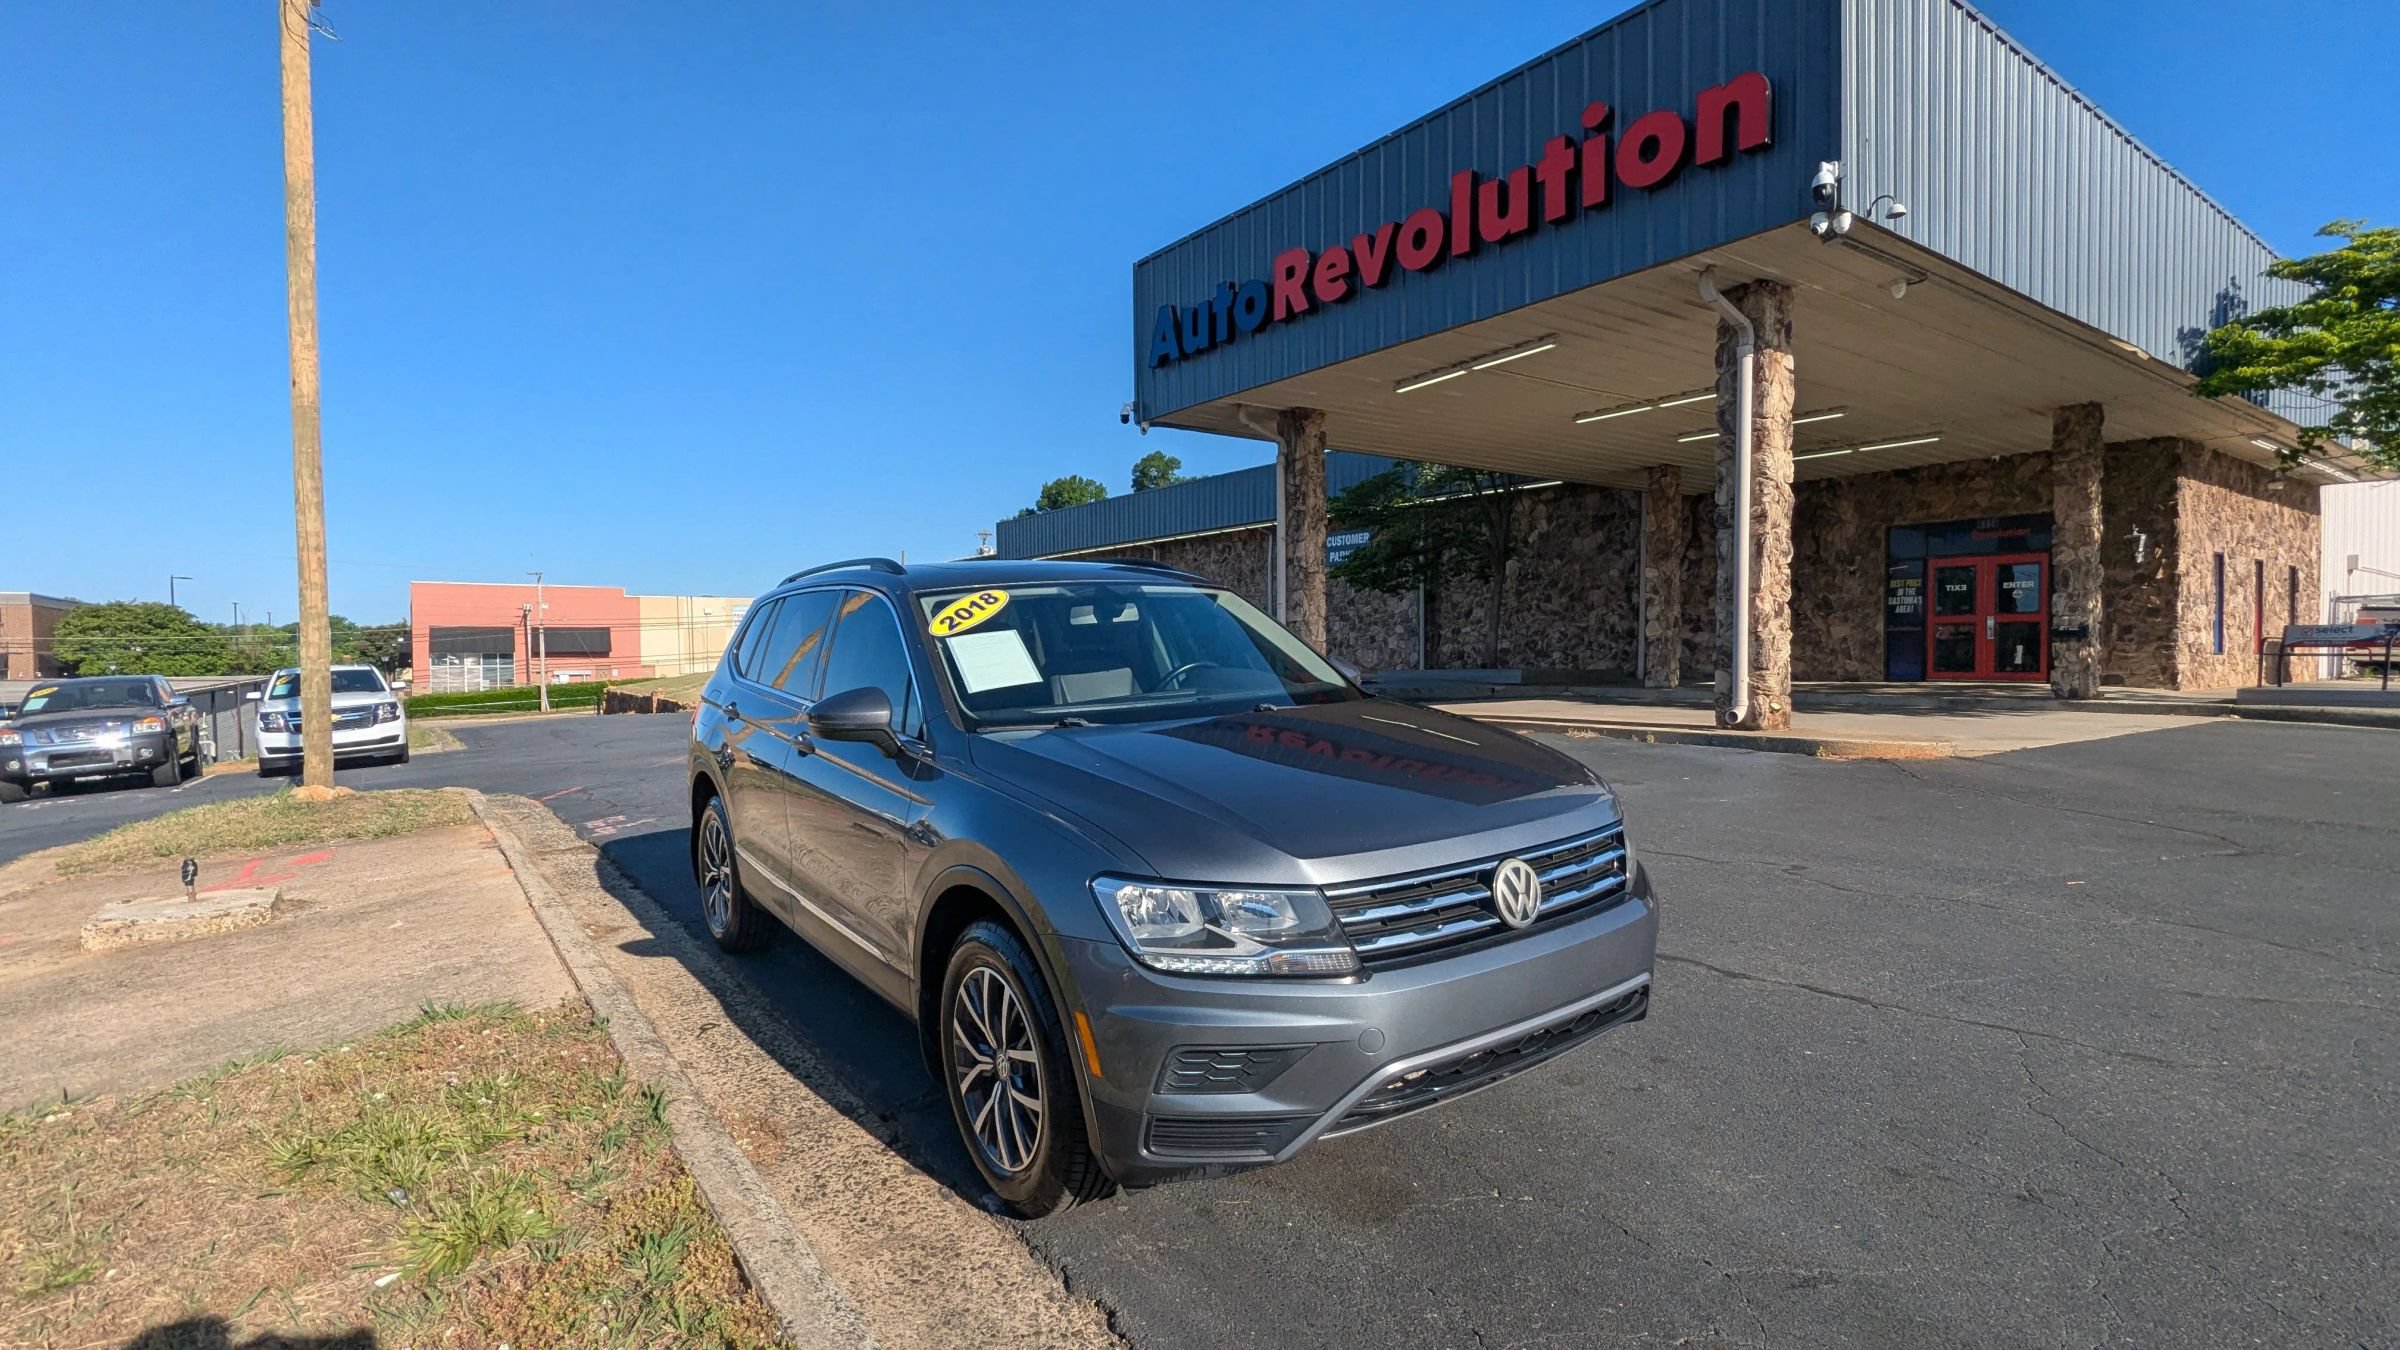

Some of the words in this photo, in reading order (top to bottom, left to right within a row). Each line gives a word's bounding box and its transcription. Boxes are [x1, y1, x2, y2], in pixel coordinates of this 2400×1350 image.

[1149, 71, 1772, 370] AutoRevolution
[1326, 532, 1370, 548] CUSTOMER
[2003, 581, 2034, 589] ENTER
[1905, 587, 1917, 596] THE
[939, 592, 1000, 631] 2018
[2314, 625, 2354, 634] select
